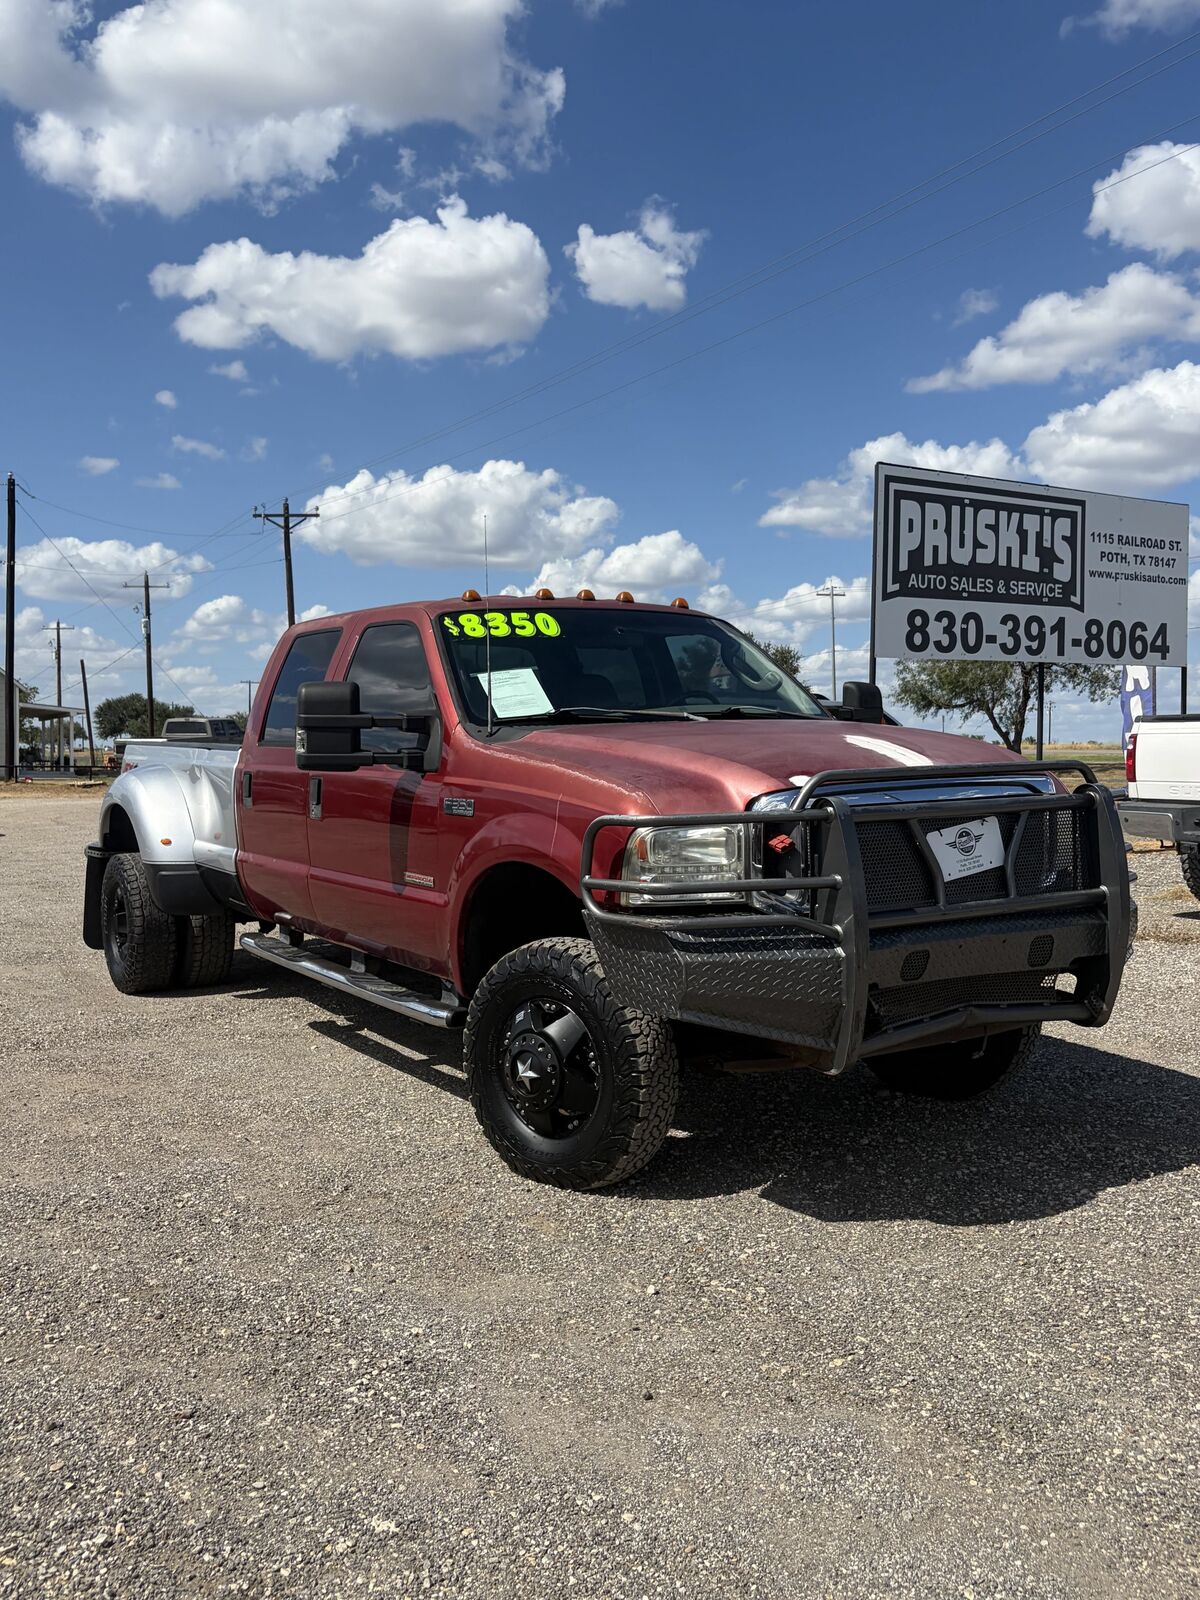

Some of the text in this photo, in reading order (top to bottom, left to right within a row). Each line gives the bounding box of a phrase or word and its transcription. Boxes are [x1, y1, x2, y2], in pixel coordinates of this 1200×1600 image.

[899, 499, 1072, 583] PRUSKI'S
[1090, 531, 1182, 552] 1115 RAILROAD ST.
[1100, 551, 1177, 569] POTH, TX 78147
[908, 573, 1063, 598] AUTO SALES & SERVICE
[1088, 569, 1187, 586] www.pruskisauto.com
[443, 612, 561, 638] $8350
[904, 608, 1171, 660] 830-391-8064
